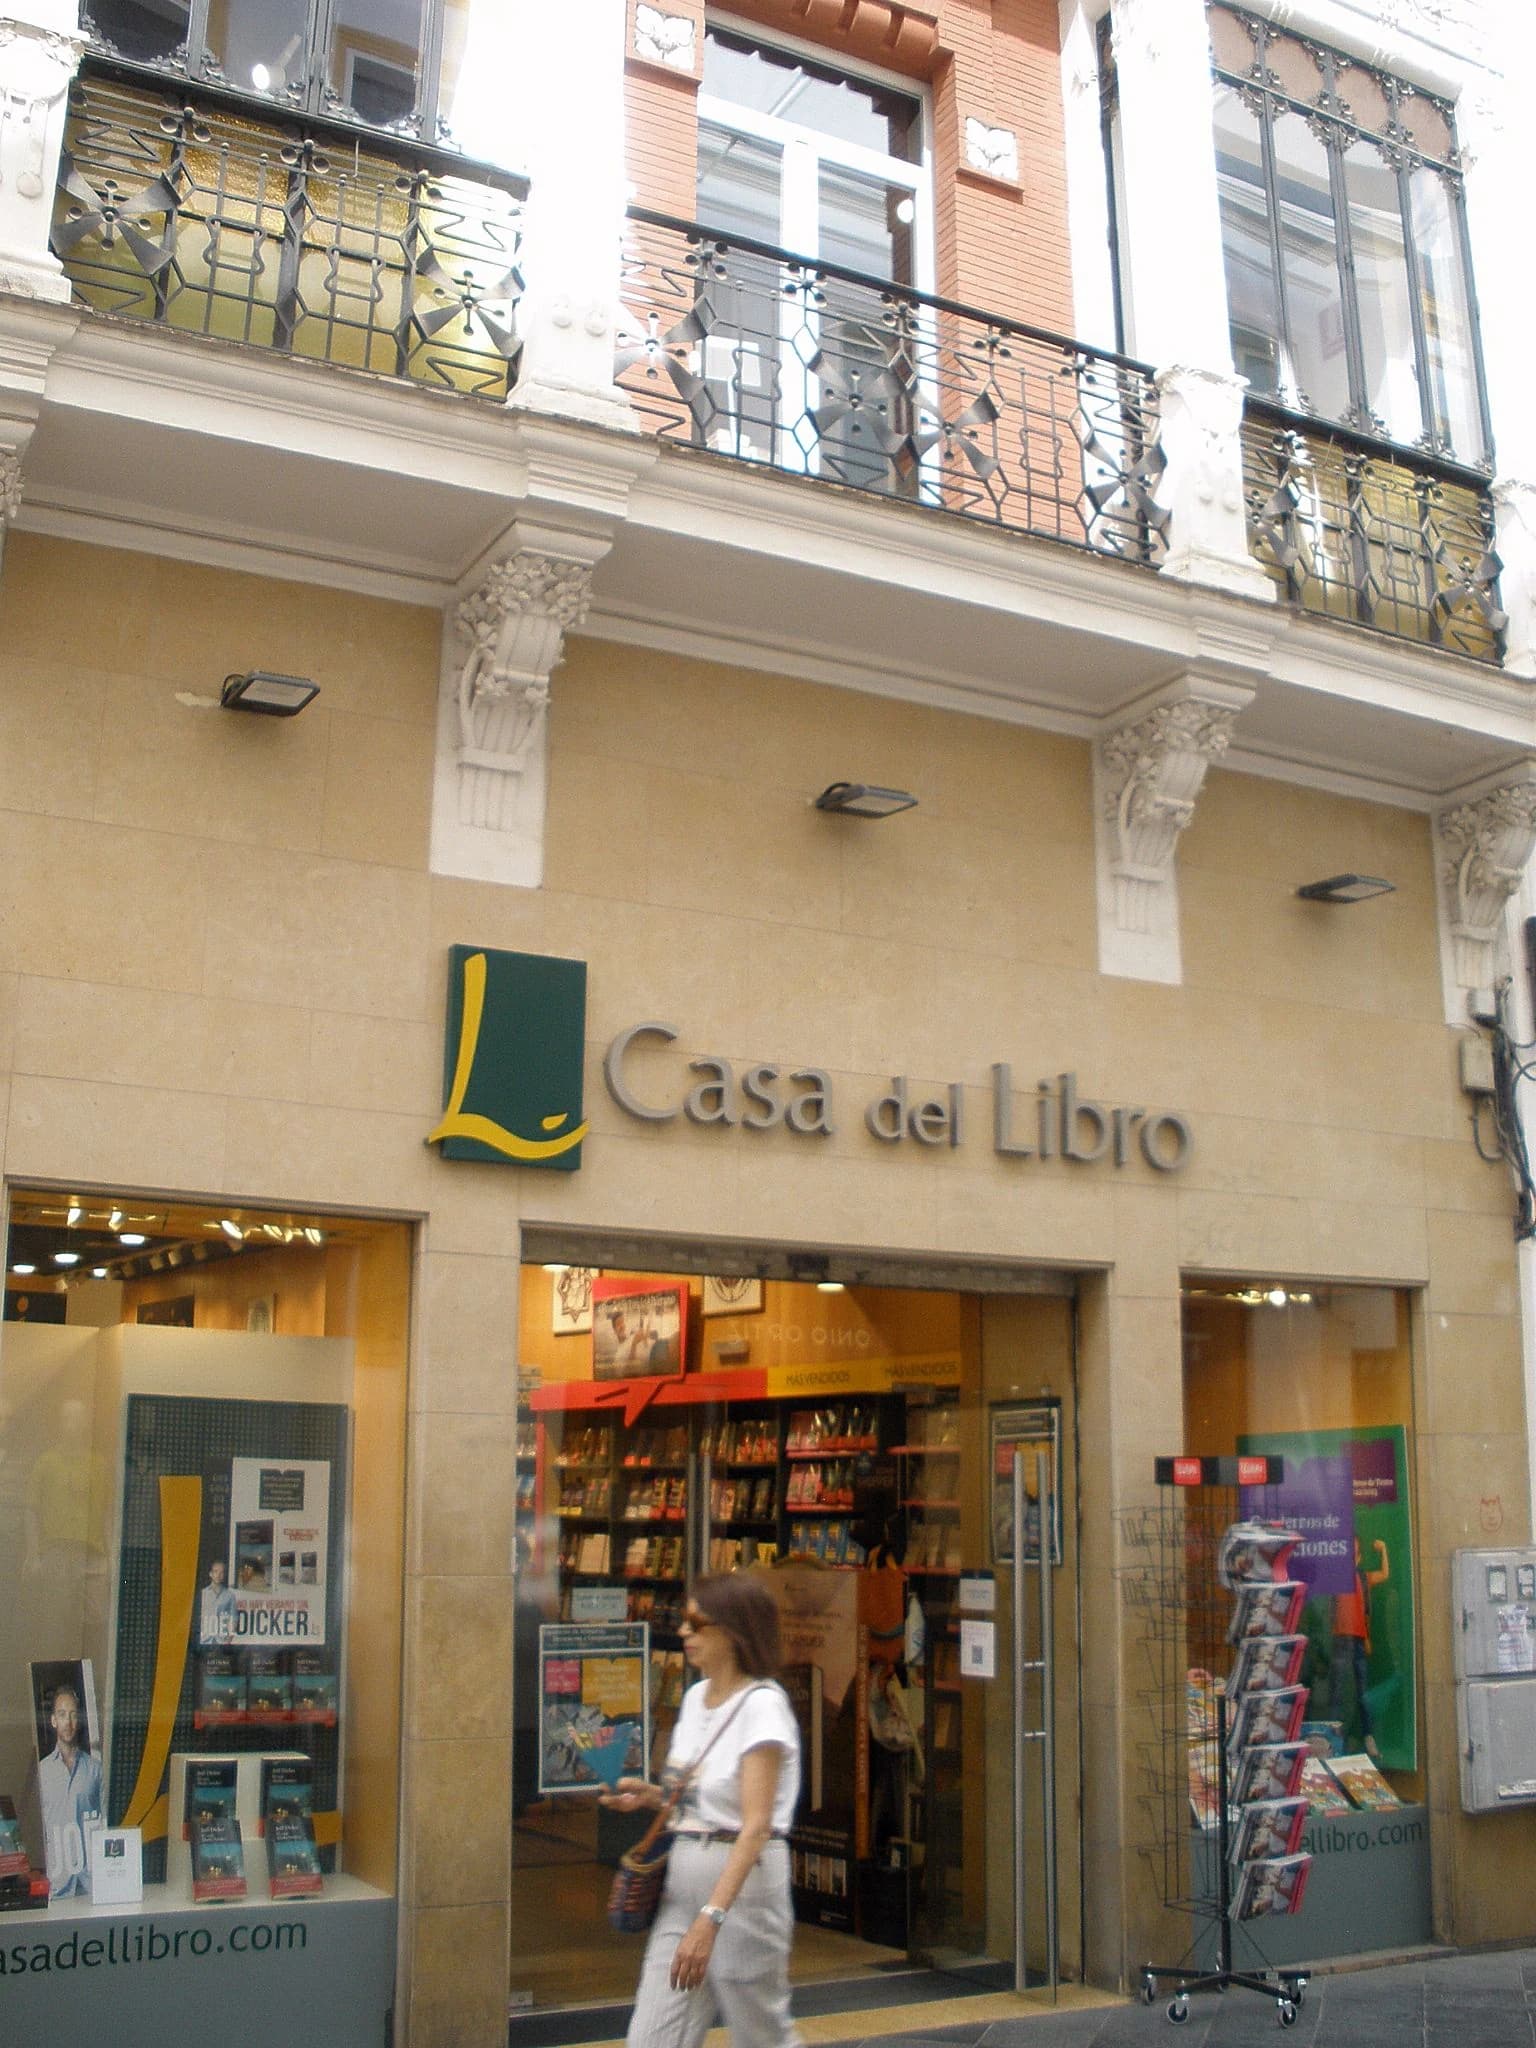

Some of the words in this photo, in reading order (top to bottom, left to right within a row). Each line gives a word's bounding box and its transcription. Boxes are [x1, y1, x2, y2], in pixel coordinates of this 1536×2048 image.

[602, 1019, 835, 1137] Casa
[865, 1074, 965, 1147] del
[991, 1061, 1195, 1172] Libro
[236, 1609, 308, 1636] DICKER
[1301, 1821, 1424, 1855] ellibro.com
